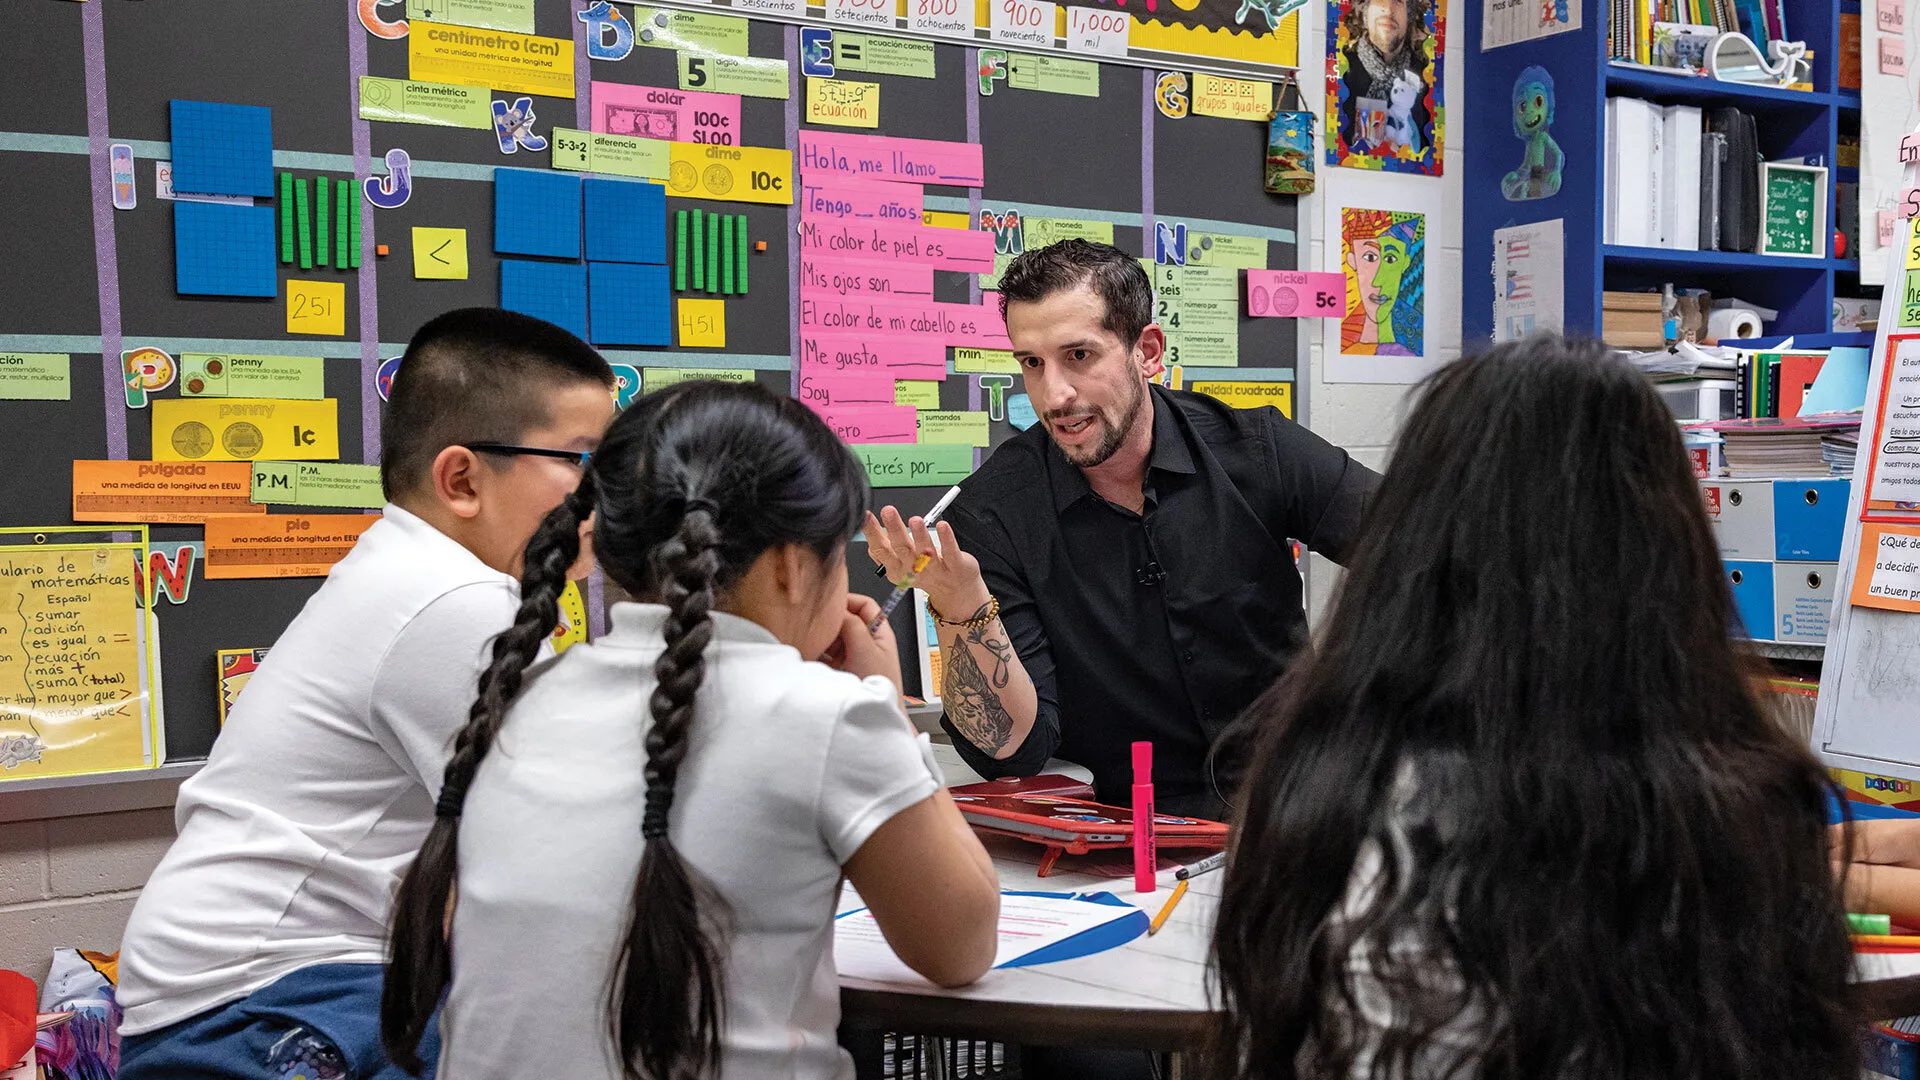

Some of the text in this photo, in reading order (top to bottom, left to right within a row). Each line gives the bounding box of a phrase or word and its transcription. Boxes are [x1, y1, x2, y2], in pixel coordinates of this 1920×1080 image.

[673, 13, 695, 22] dime
[1002, 0, 1041, 26] 900
[916, 17, 966, 31] ochocientos
[1072, 10, 1125, 35] 1,000
[999, 29, 1045, 44] novecientos
[1084, 36, 1100, 49] mil
[523, 38, 559, 57] (cm)
[801, 26, 835, 77] E
[868, 39, 934, 52] ecuación correcta
[450, 48, 477, 58] unidad
[478, 52, 509, 62] métrica
[522, 57, 552, 68] longitud
[688, 57, 707, 87] 5
[977, 48, 1006, 97] F
[406, 84, 467, 98] cinta métrica
[646, 90, 687, 107] dolár
[813, 103, 867, 120] ecuación
[1194, 96, 1268, 115] grupos iguales
[694, 111, 730, 128] 100¢
[594, 137, 637, 149] diferencia
[692, 131, 732, 146] $1.00
[704, 145, 742, 161] dime
[803, 143, 936, 177] Hola, me llamo
[750, 170, 783, 192] 10¢
[805, 185, 853, 219] Tengo
[879, 201, 922, 221] años.
[1055, 222, 1083, 230] moneda
[803, 221, 945, 258] Mi color de piel es
[802, 261, 891, 297] Mis ojos son
[1166, 269, 1173, 281] 6
[1274, 273, 1308, 285] nickel
[1160, 284, 1181, 296] seis
[292, 293, 332, 320] 251
[1316, 291, 1337, 309] 5¢
[1159, 301, 1168, 317] 2
[682, 314, 715, 336] 451
[802, 300, 977, 336] El color de mi cabello es
[1169, 312, 1181, 329] 4
[804, 338, 879, 370] Me gusta
[1170, 346, 1179, 363] 3
[230, 358, 264, 368] penny
[1902, 358, 1909, 367] El
[802, 376, 830, 407] Soy
[1199, 384, 1285, 397] unidad cuadrada
[219, 403, 276, 419] penny
[293, 425, 316, 447] 1¢
[1887, 444, 1919, 455] somos muy
[138, 462, 206, 478] pulgada
[300, 465, 321, 475] P.M.
[865, 454, 936, 480] terés por
[1883, 461, 1911, 470] nuestros
[120, 481, 155, 489] medida
[170, 482, 207, 491] longitud
[221, 482, 241, 490] EEUU
[256, 472, 293, 489] P.M.
[1881, 477, 1902, 488] amigos
[1704, 488, 1713, 497] Do
[1705, 496, 1716, 505] The
[286, 518, 310, 533] pie
[249, 535, 283, 543] medida
[296, 535, 331, 544] longitud
[1880, 536, 1908, 549] ¿Qué
[0, 556, 76, 578] ulario de
[1876, 560, 1919, 574] a decidir
[31, 573, 130, 590] matemáticas
[1870, 584, 1908, 598] un buen
[47, 593, 91, 606] Español
[35, 610, 81, 622] sumar
[33, 620, 85, 635] adición
[1782, 613, 1794, 636] 5
[32, 635, 107, 649] es igual a
[34, 647, 101, 665] ecuación
[34, 662, 65, 676] más
[36, 672, 126, 689] suma (total)
[47, 689, 117, 708] mayor que
[91, 705, 116, 721] que
